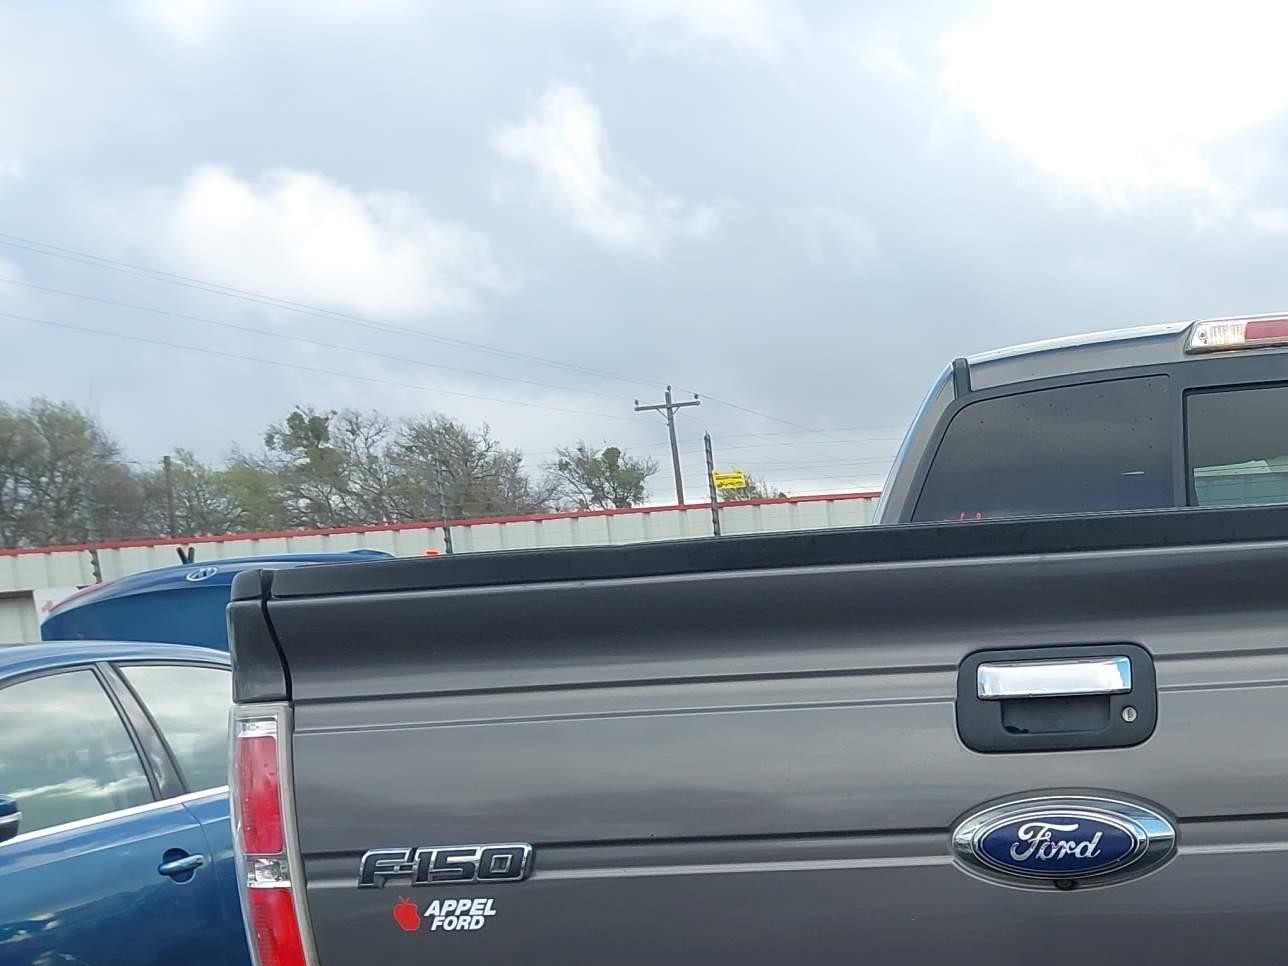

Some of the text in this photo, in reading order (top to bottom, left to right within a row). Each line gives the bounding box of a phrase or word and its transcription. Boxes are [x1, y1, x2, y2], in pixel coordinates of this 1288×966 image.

[1010, 822, 1103, 862] Ford
[358, 843, 533, 888] F-150
[424, 899, 496, 917] APPEL
[430, 916, 485, 931] FORD
